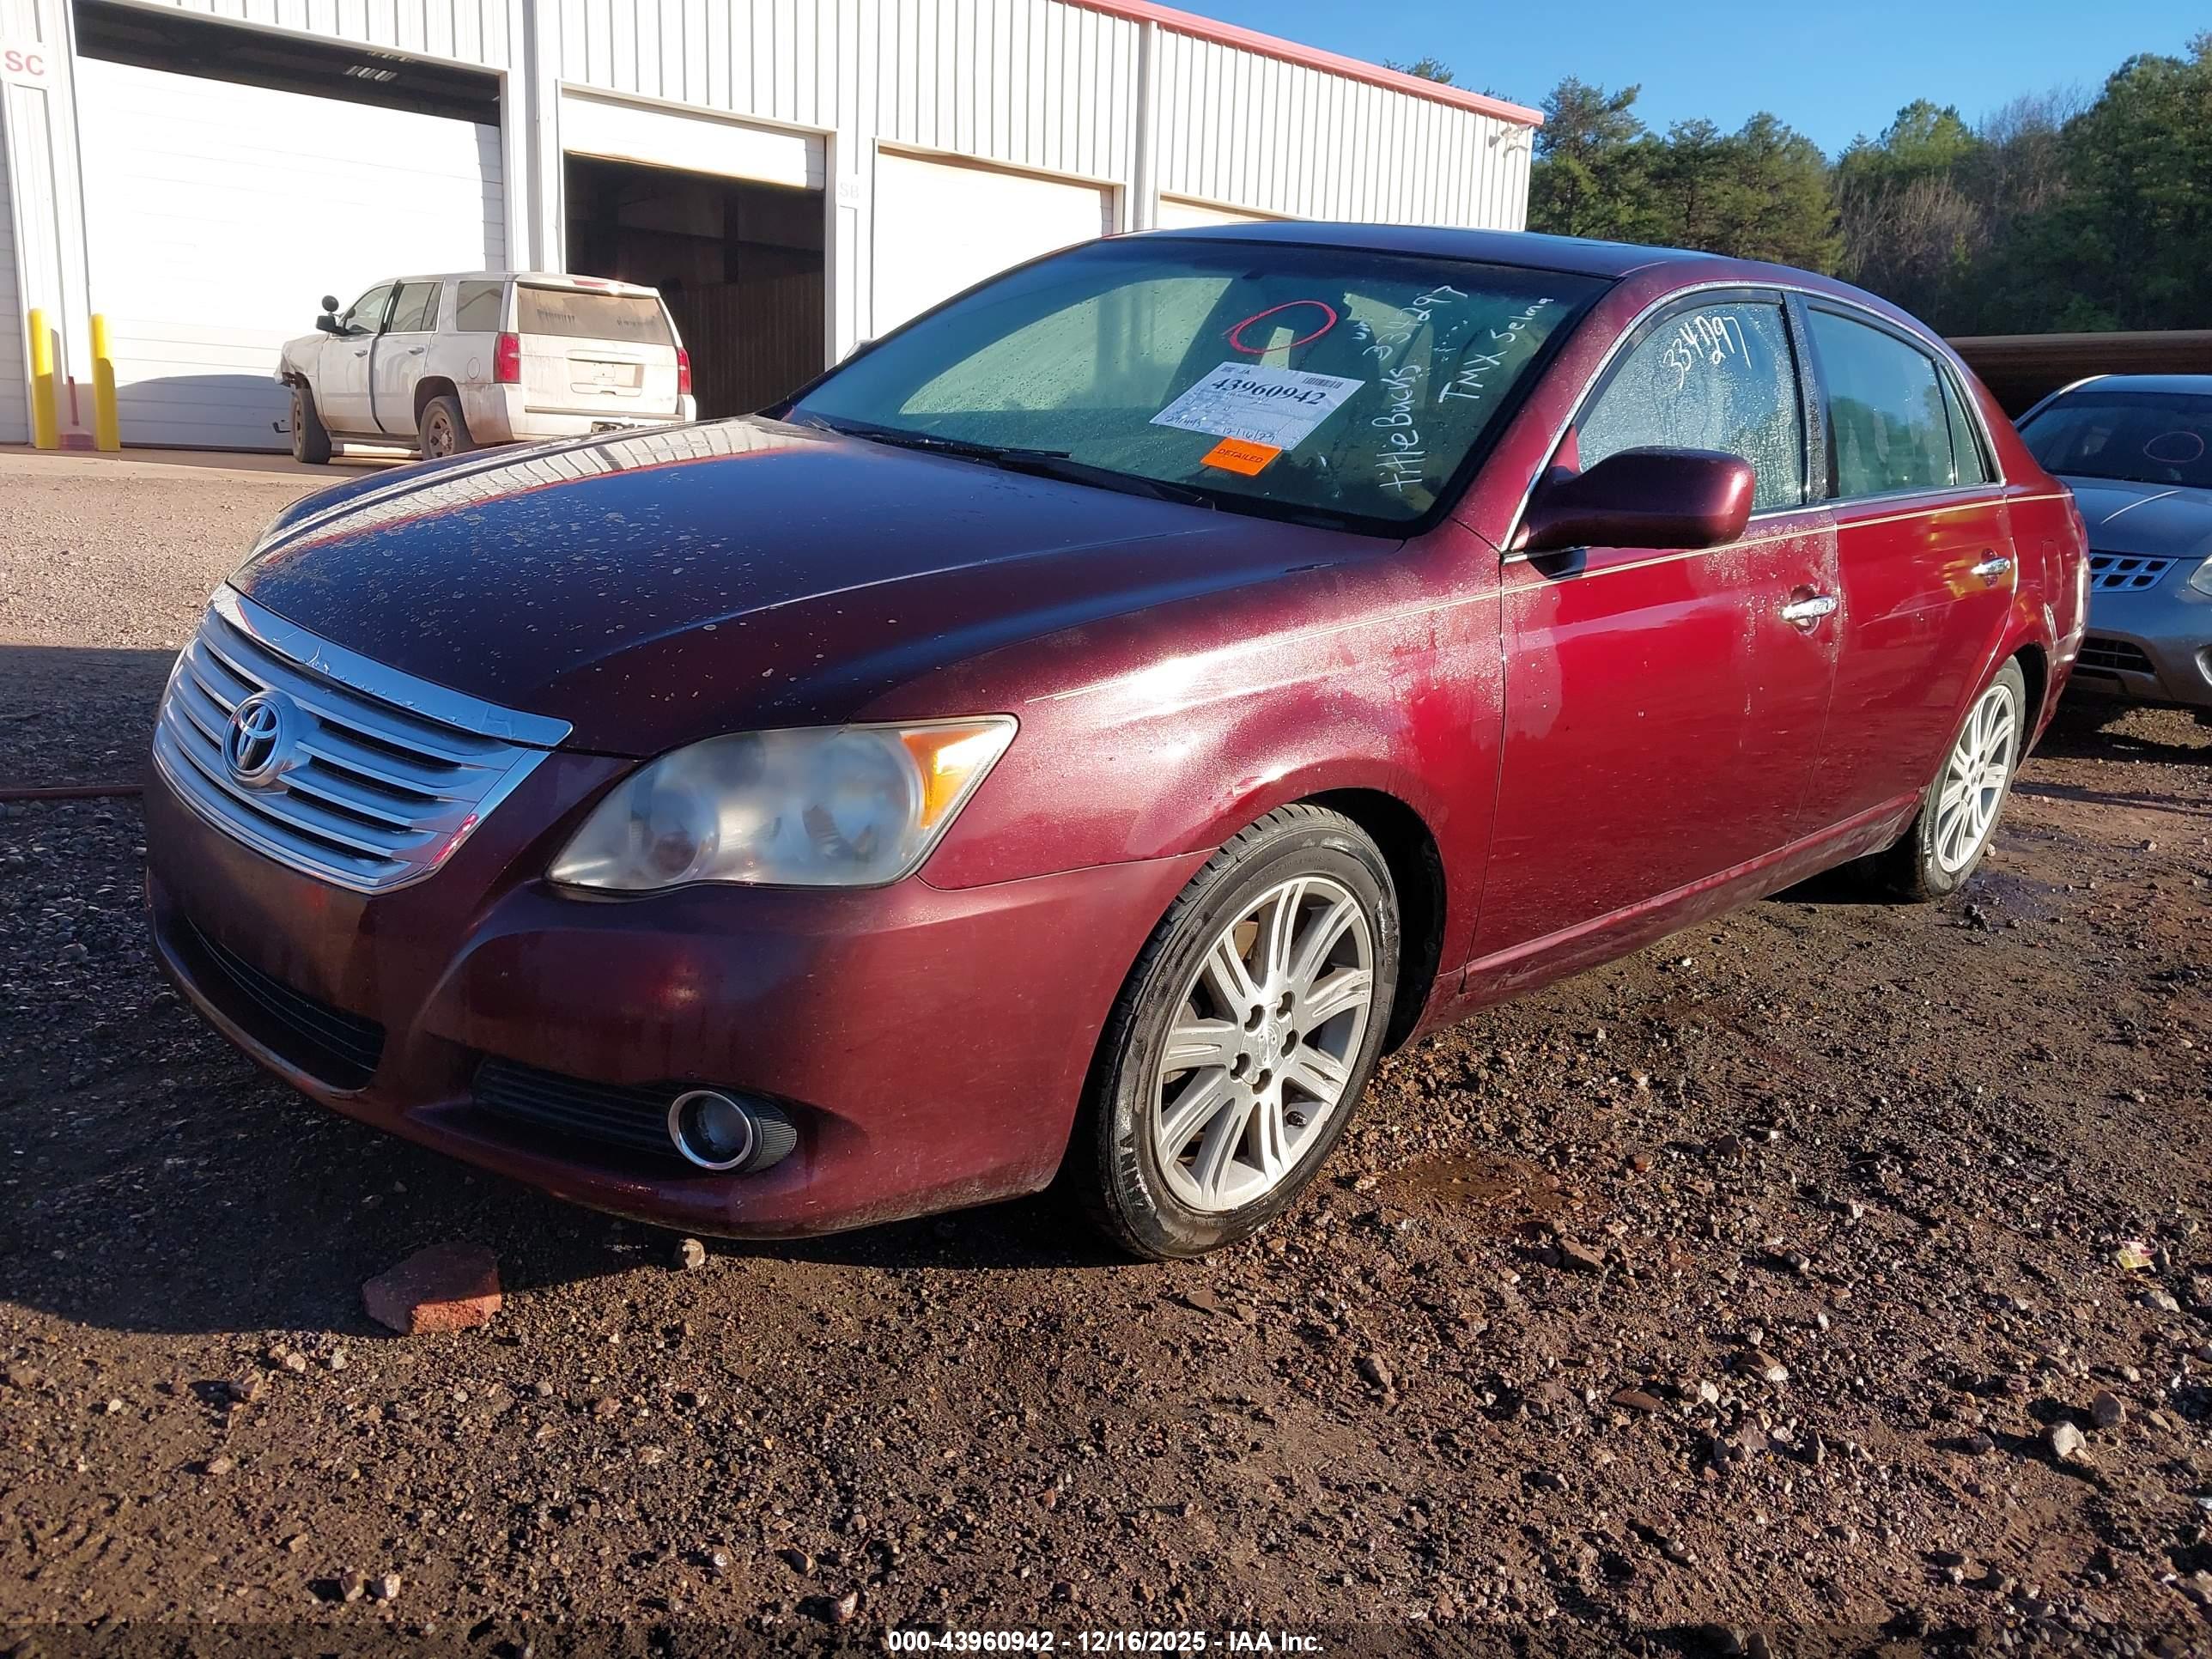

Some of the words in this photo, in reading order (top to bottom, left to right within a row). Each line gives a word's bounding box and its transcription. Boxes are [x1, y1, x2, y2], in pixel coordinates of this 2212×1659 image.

[5, 50, 45, 76] SC
[1662, 315, 1752, 390] 334297
[1211, 378, 1328, 405] 43960942
[1217, 447, 1264, 464] DETAILED
